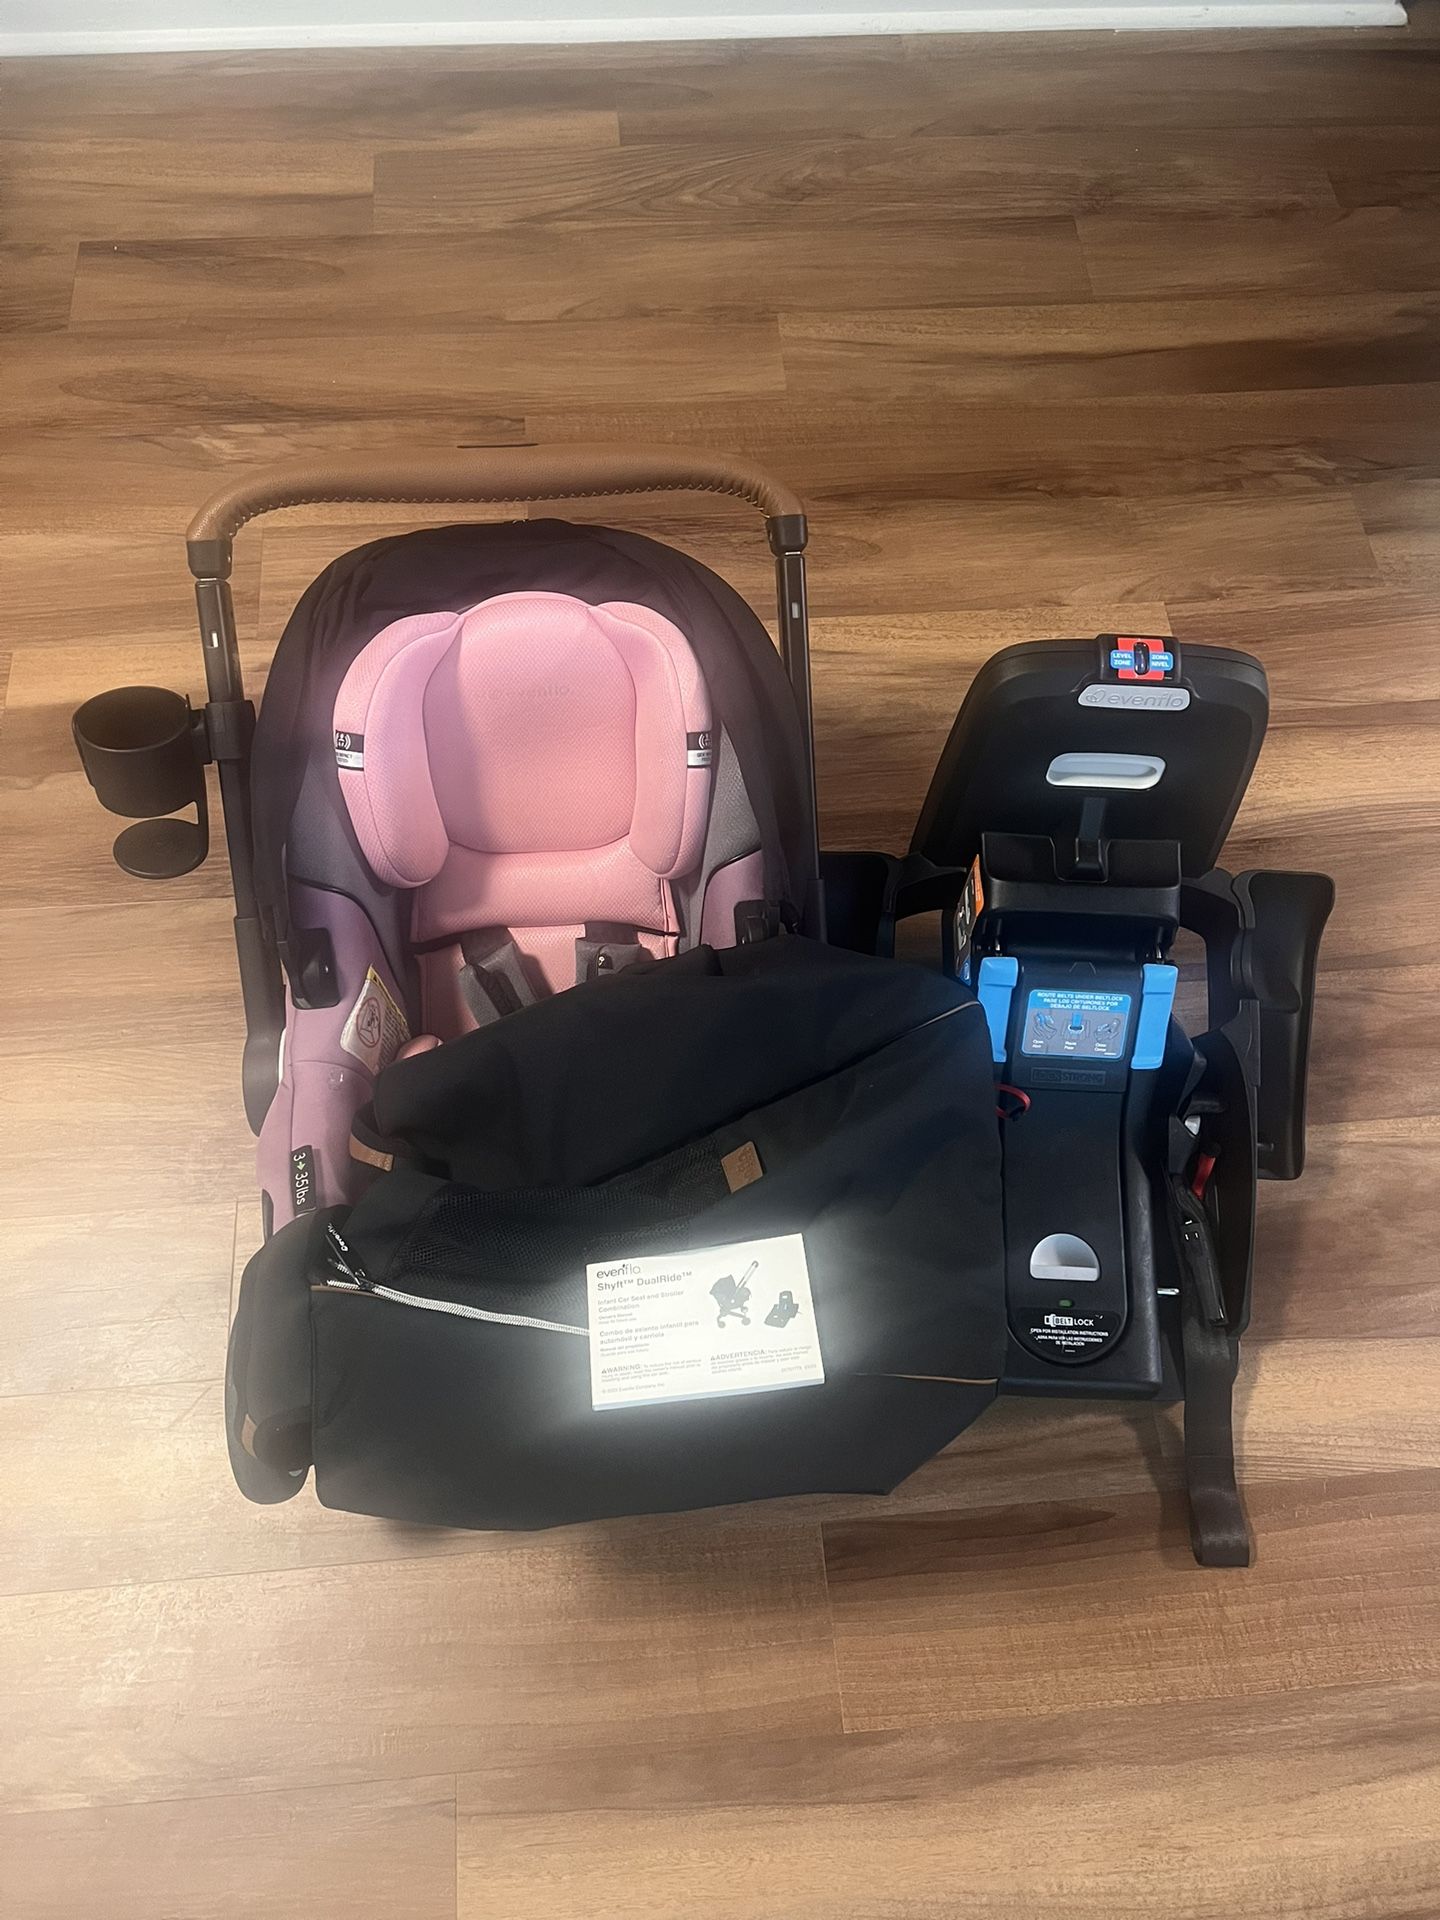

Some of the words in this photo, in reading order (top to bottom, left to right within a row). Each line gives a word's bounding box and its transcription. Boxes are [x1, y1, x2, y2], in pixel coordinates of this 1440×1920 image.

[1108, 692, 1184, 708] evenflo
[293, 1152, 306, 1161] 3
[295, 1171, 309, 1205] 35lbs
[596, 1263, 641, 1279] evenflo
[598, 1296, 617, 1306] Infant
[631, 1293, 646, 1302] Seat
[598, 1303, 640, 1313] Combination
